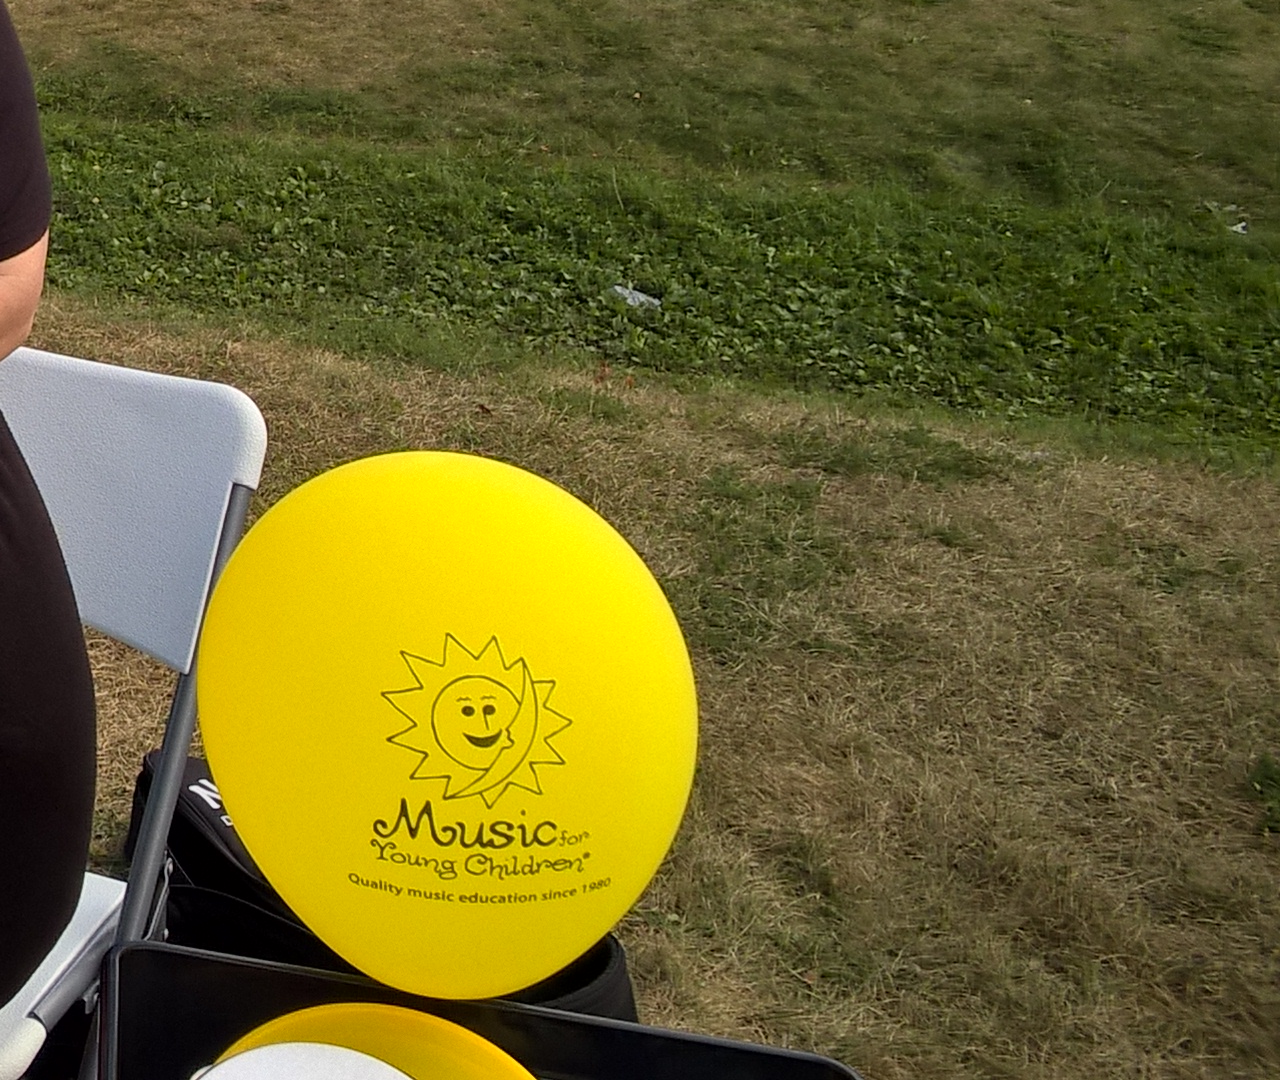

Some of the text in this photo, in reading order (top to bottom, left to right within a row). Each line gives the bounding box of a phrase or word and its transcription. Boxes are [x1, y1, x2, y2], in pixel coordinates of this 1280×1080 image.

[373, 797, 590, 849] Music for
[370, 838, 458, 880] Young
[348, 873, 612, 904] Quality music education since 1980
